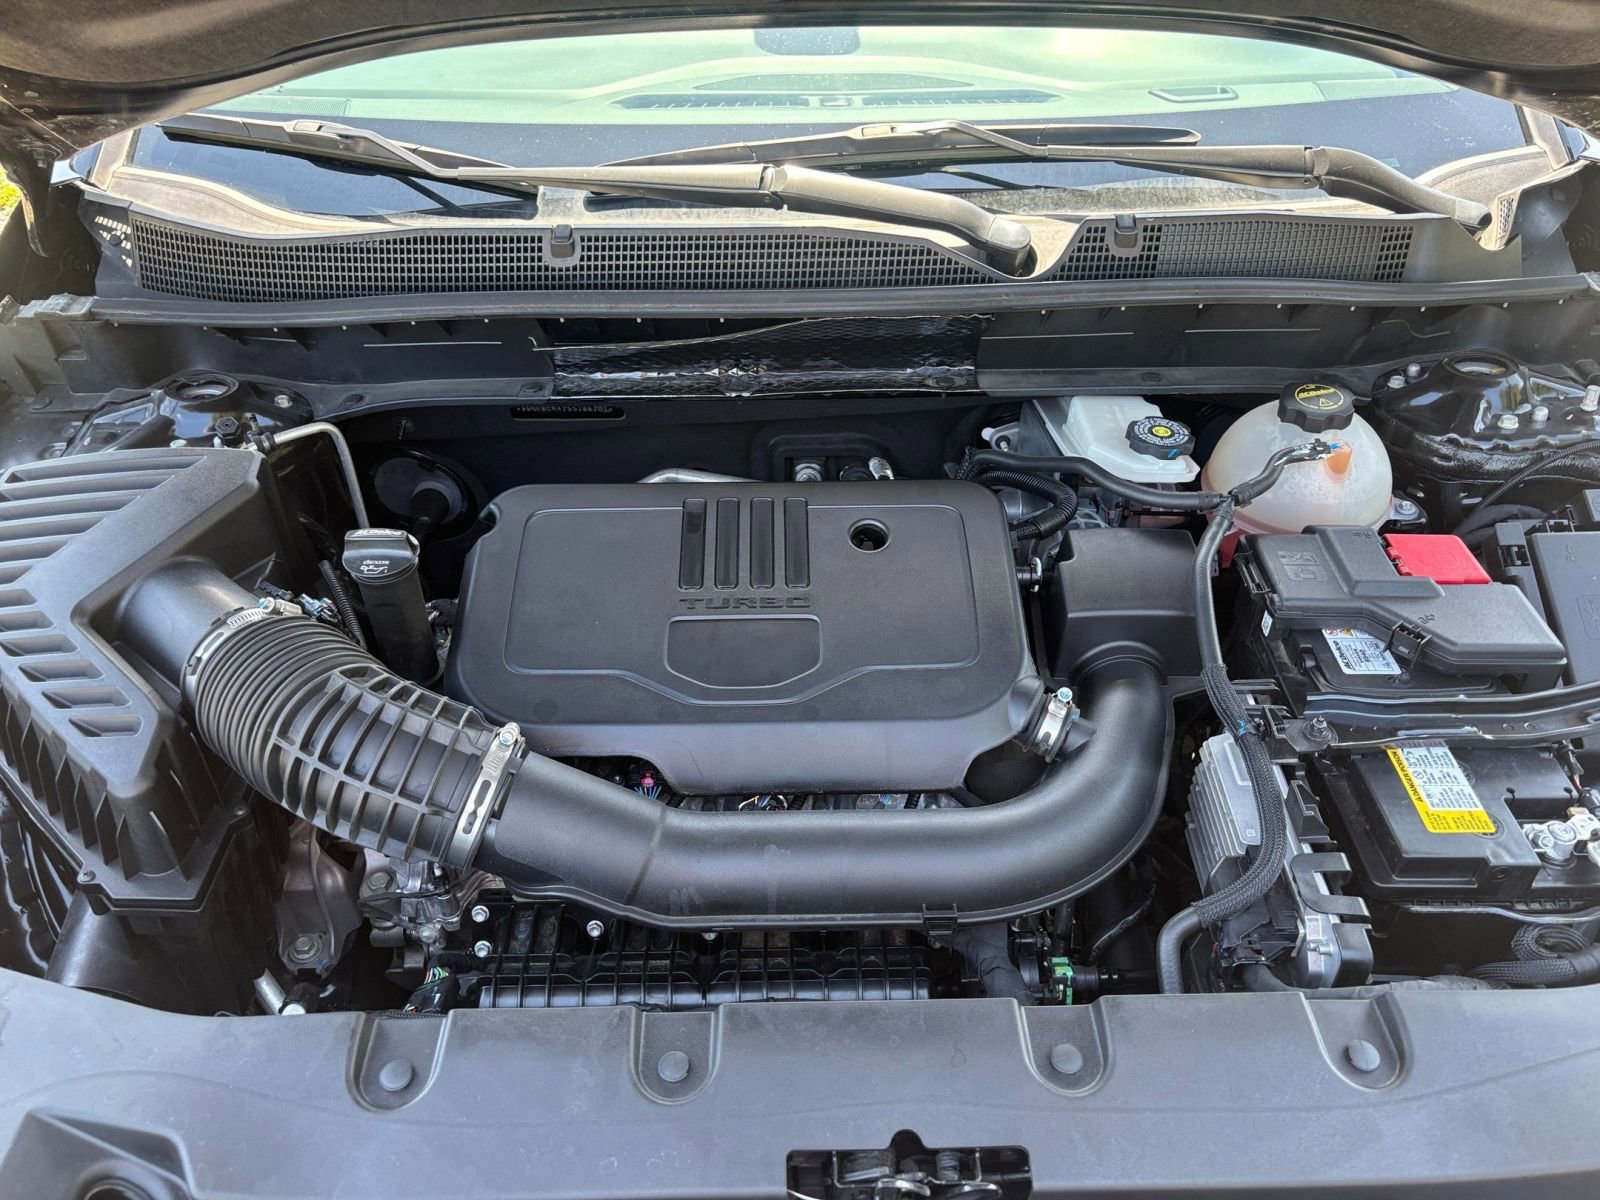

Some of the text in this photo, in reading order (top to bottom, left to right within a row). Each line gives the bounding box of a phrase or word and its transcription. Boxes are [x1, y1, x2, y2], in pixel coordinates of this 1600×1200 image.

[679, 597, 811, 609] TURBO
[1391, 750, 1420, 797] DANGER POISON
